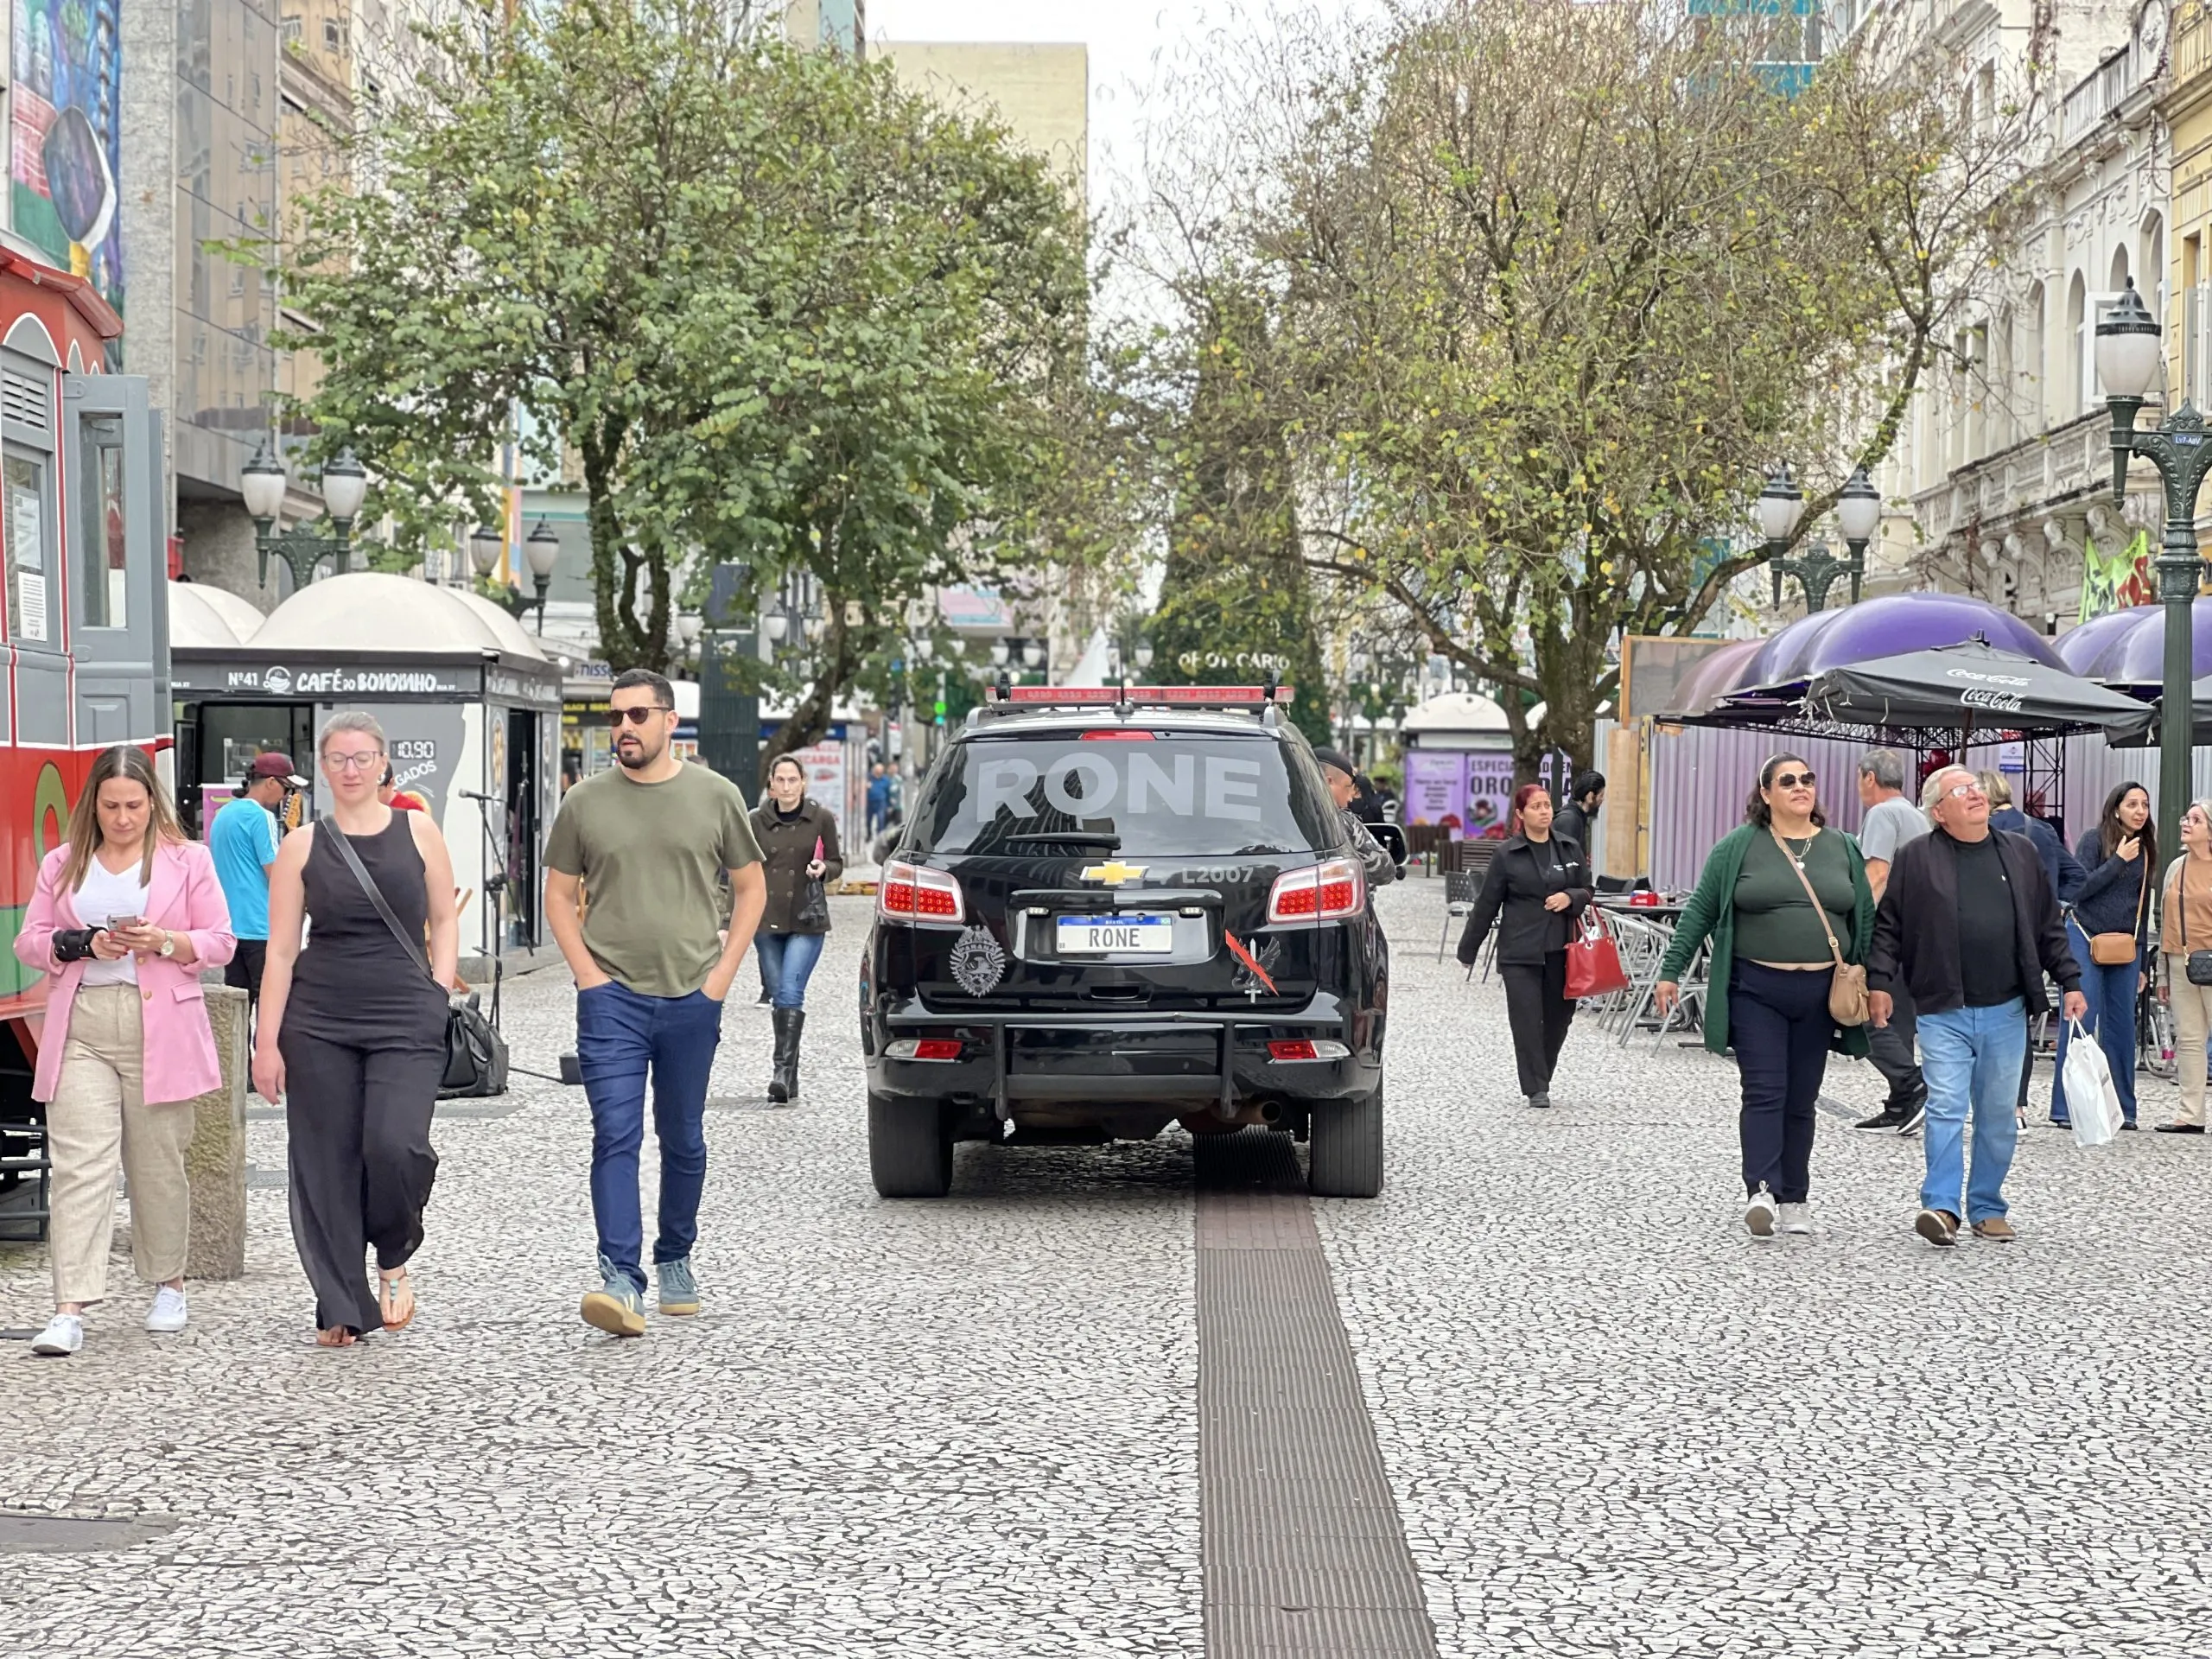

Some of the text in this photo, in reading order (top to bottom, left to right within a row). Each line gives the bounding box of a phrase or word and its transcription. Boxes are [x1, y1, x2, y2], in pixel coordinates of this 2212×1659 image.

[296, 668, 343, 692] CAFÉ
[343, 678, 356, 691] DO
[357, 672, 437, 693] BONDINHO
[1960, 687, 2026, 713] Coca-Cola
[394, 760, 437, 788] GADOS
[976, 752, 1262, 823] RONE
[1182, 867, 1253, 884] L2007
[1089, 928, 1141, 948] RONE
